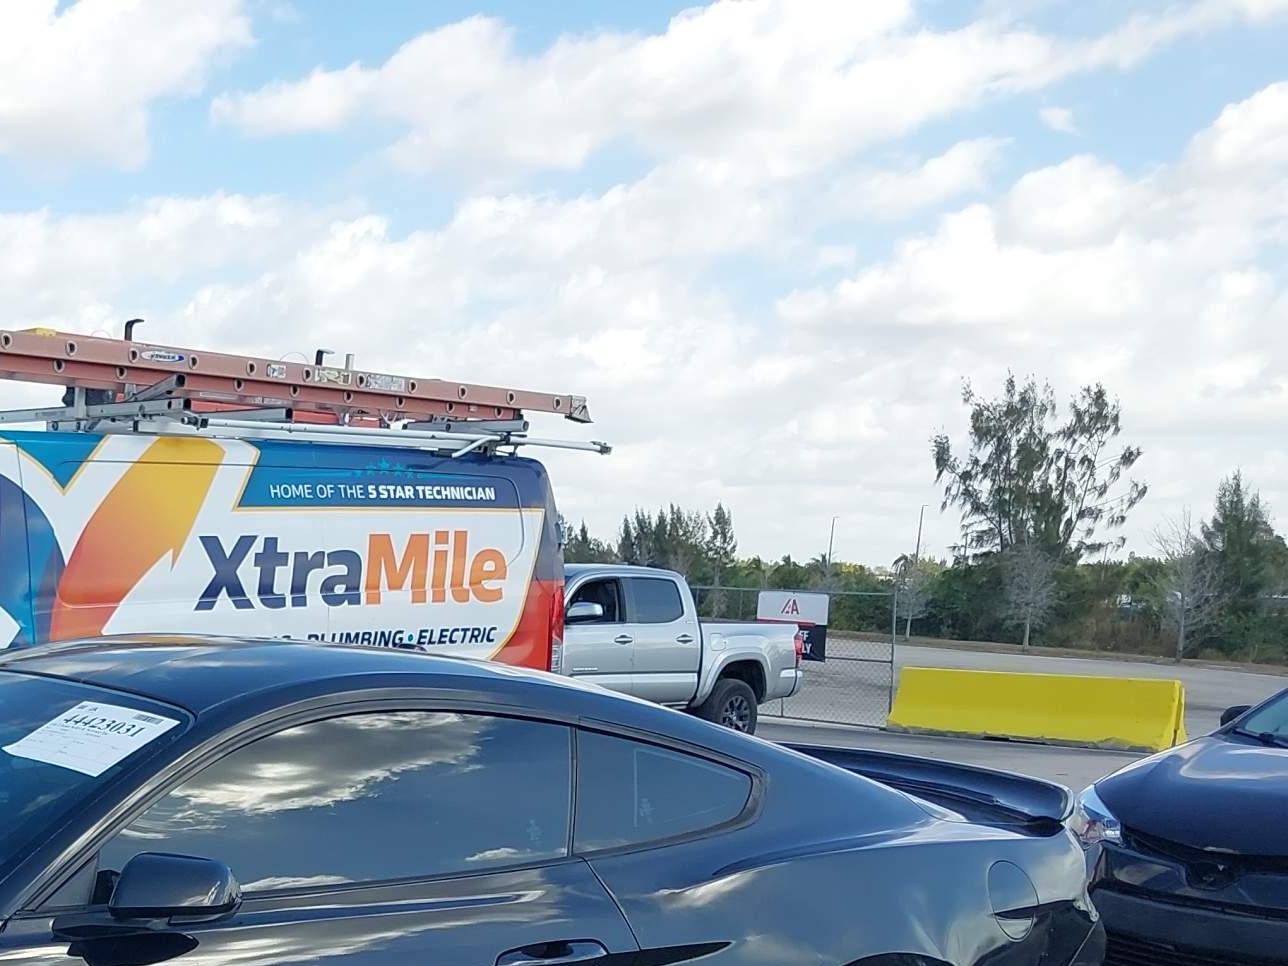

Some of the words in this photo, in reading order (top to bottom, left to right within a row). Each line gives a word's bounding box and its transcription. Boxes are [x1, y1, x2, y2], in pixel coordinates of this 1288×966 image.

[270, 484, 313, 499] HOME
[316, 484, 335, 499] OF
[338, 484, 365, 499] THE
[368, 485, 377, 499] 5
[379, 485, 415, 499] STAR
[416, 486, 496, 500] TECHNICIAN
[194, 529, 508, 611] XtraMile
[416, 626, 498, 646] ELECTRIC
[63, 713, 146, 737] 44423031
